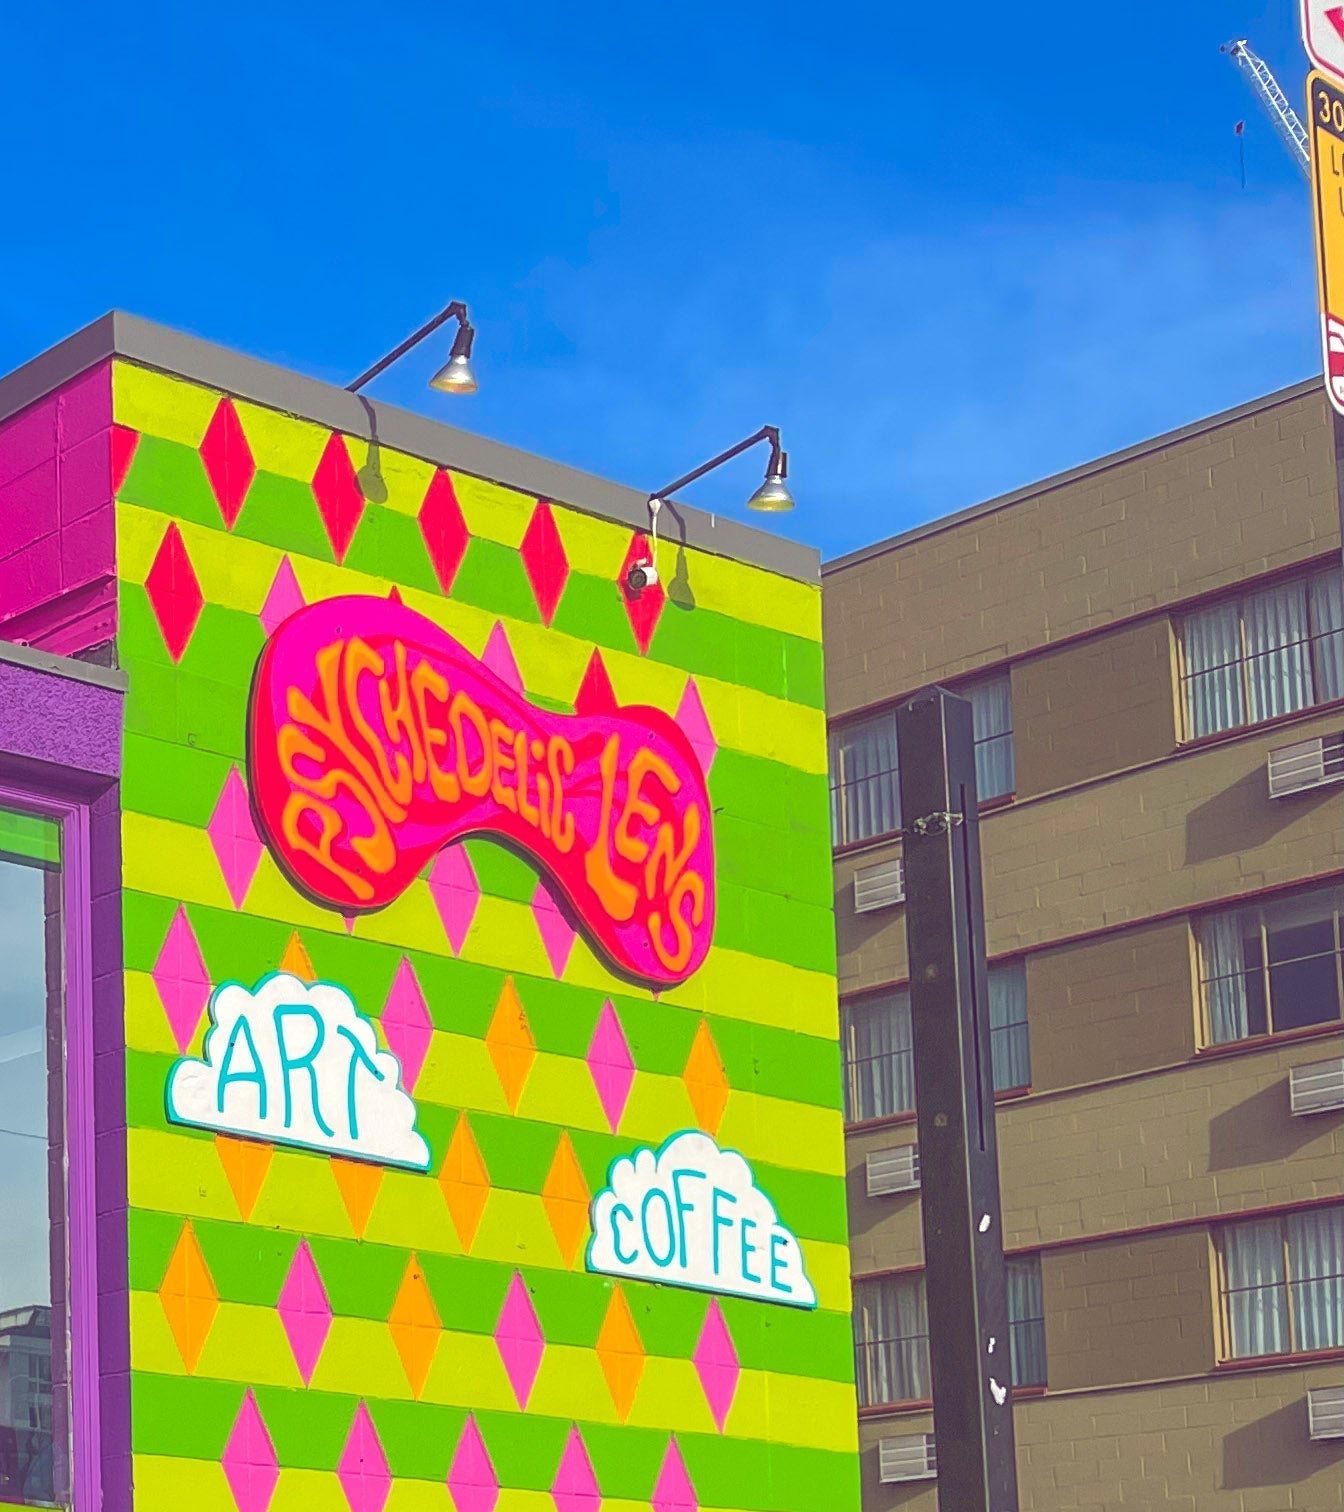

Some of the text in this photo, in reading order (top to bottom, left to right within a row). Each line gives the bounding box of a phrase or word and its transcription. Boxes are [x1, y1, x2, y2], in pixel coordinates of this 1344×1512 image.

[276, 635, 705, 973] PSYCHEDELIC LENS
[216, 1003, 386, 1141] ART
[611, 1167, 794, 1295] COFFEE
